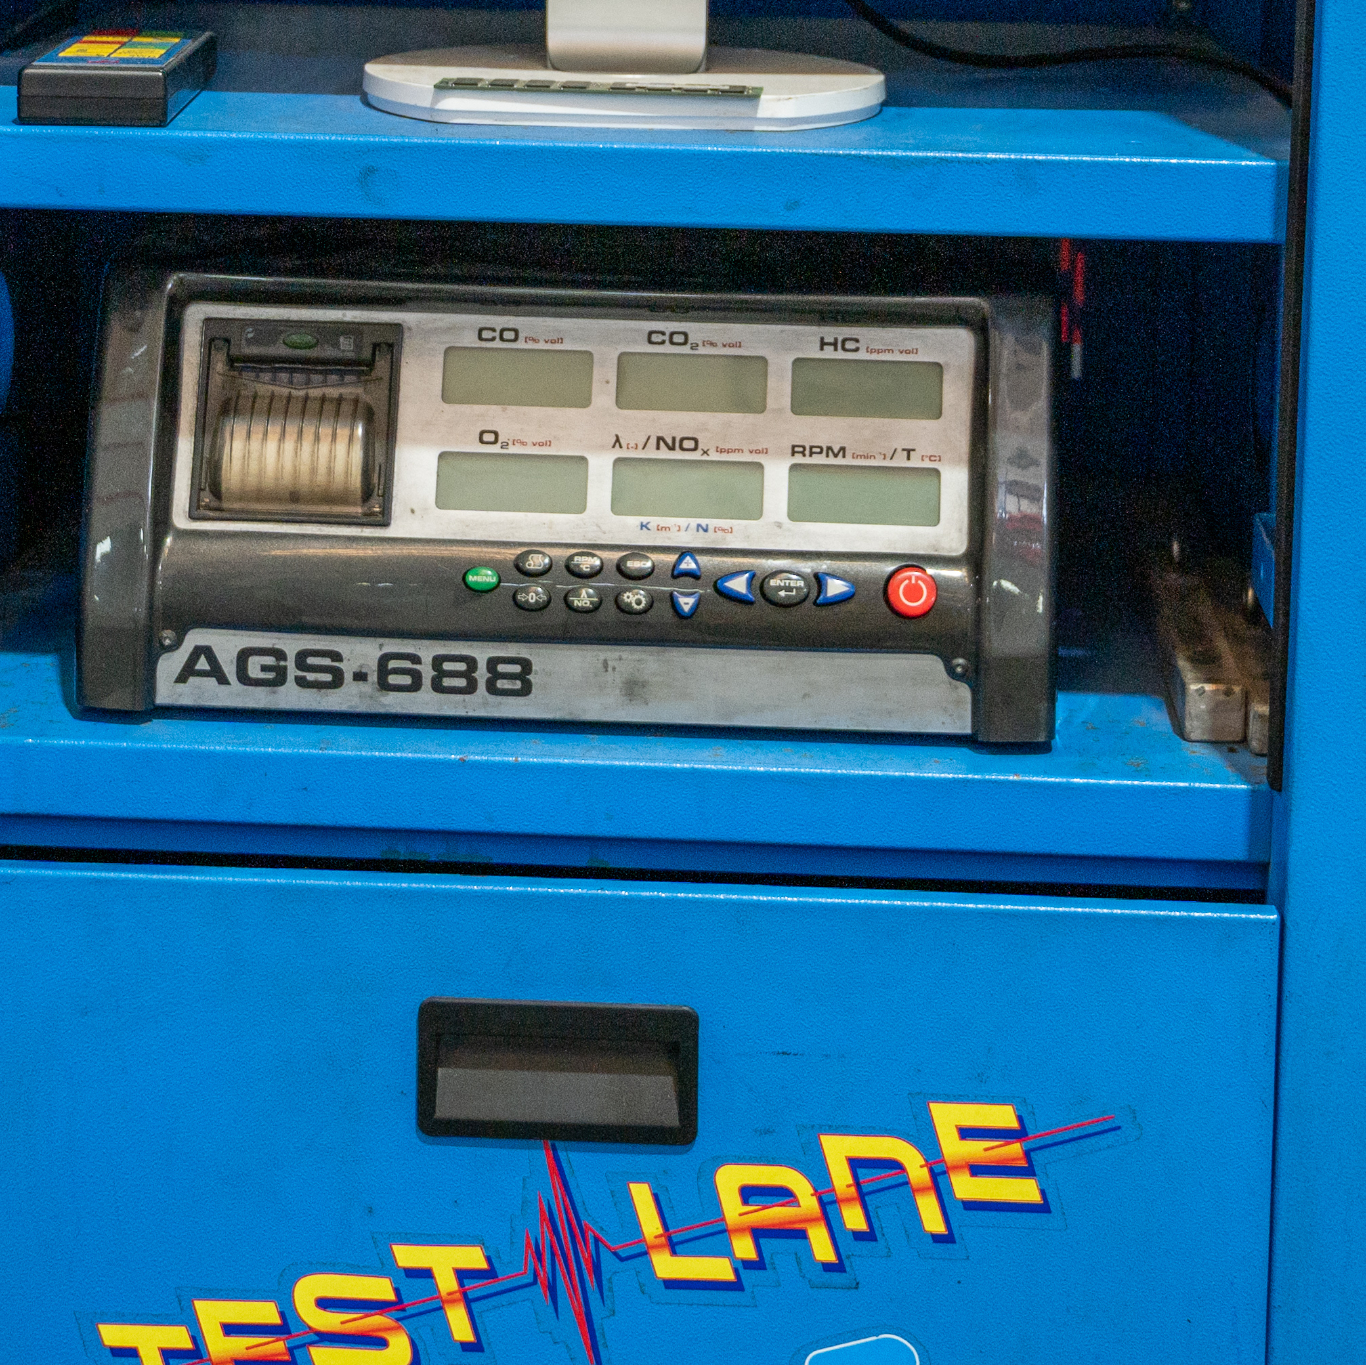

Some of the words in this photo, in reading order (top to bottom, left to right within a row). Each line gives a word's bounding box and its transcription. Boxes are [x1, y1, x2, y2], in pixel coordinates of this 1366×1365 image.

[477, 326, 520, 343] CO
[819, 336, 861, 353] HC
[790, 444, 847, 459] RPM
[639, 521, 652, 531] K
[696, 523, 709, 533] N
[573, 555, 598, 563] RPM
[468, 574, 497, 583] MENU
[769, 579, 805, 587] ENTER
